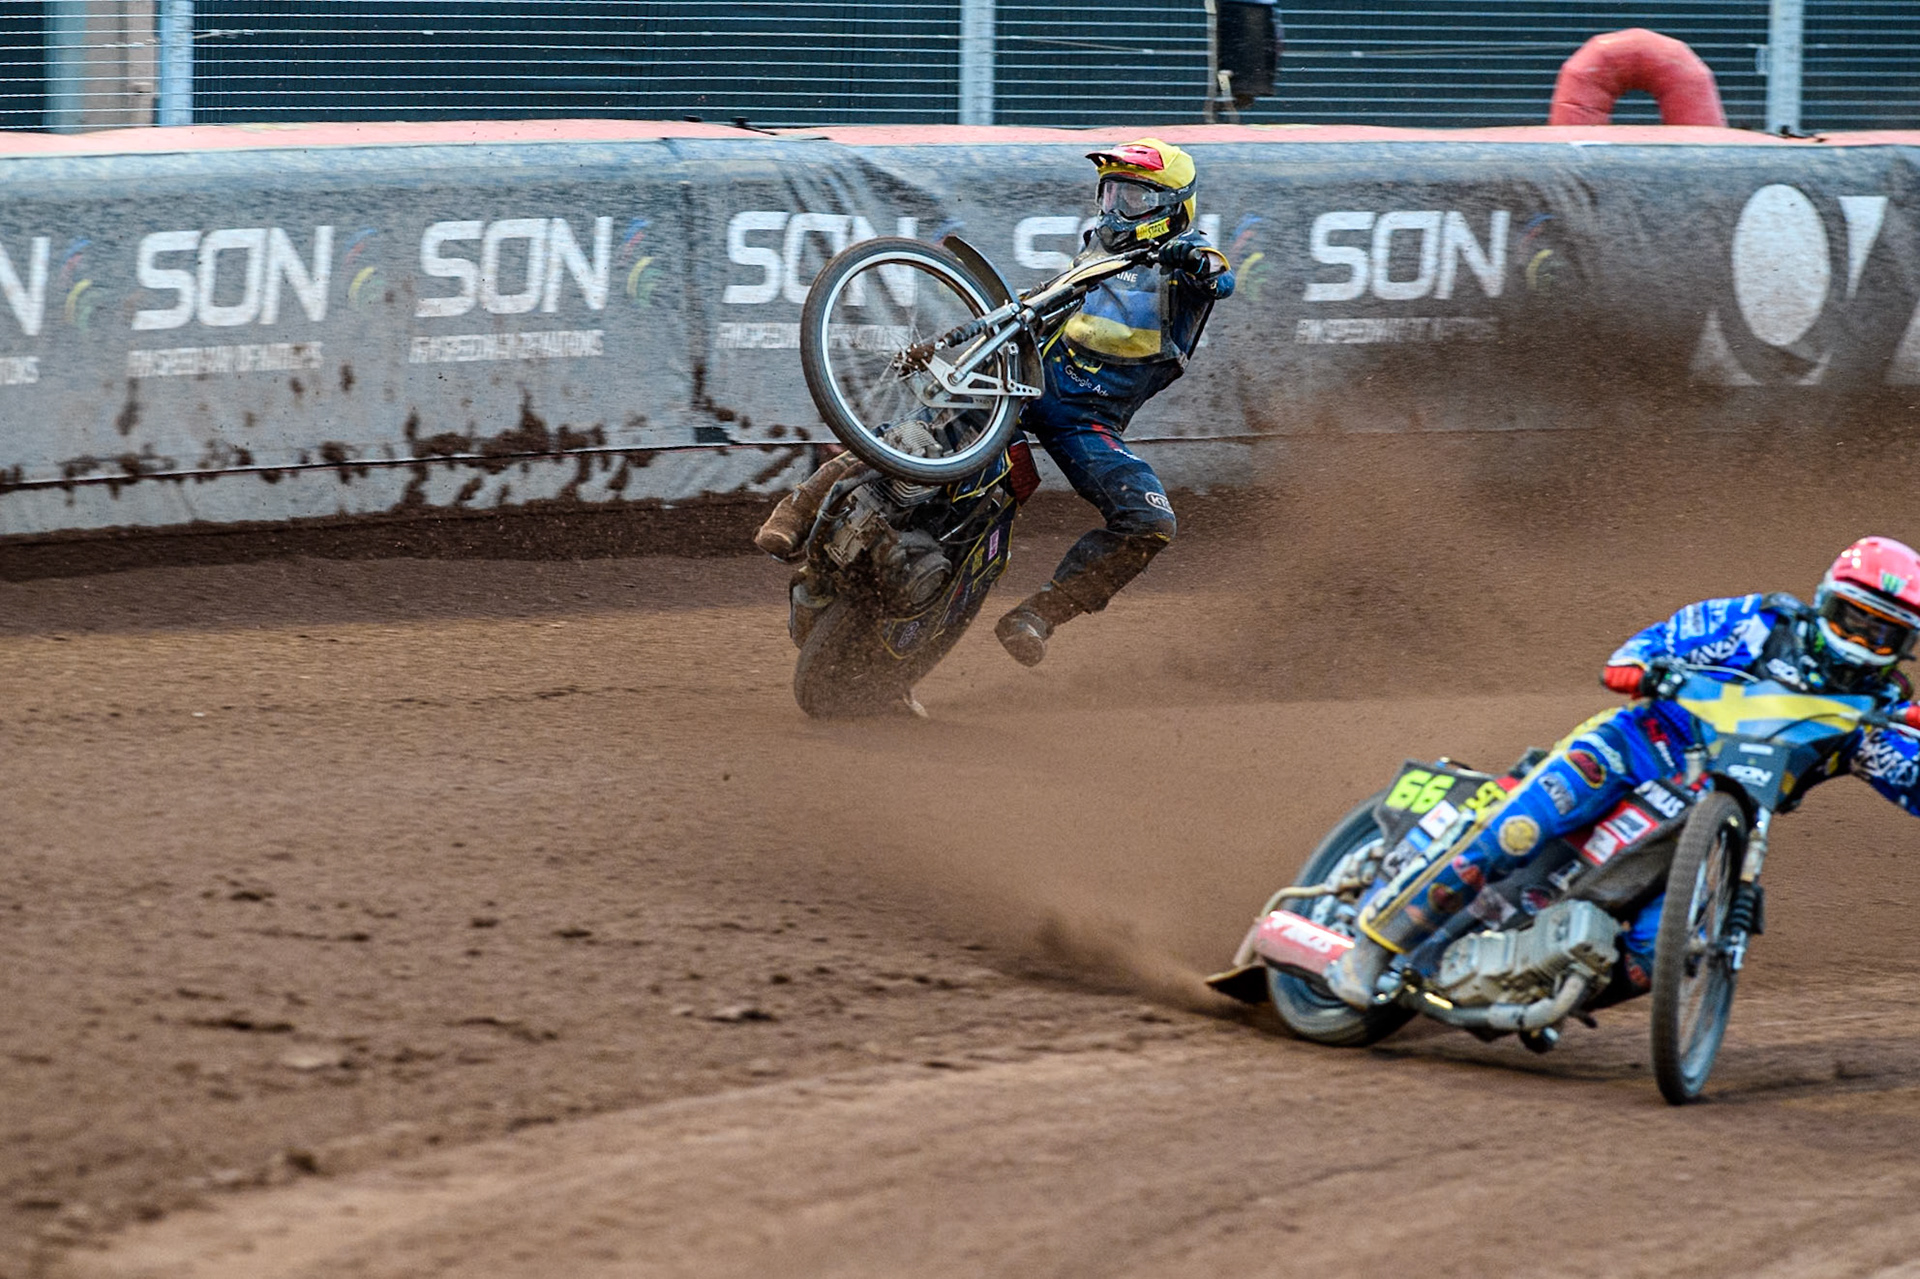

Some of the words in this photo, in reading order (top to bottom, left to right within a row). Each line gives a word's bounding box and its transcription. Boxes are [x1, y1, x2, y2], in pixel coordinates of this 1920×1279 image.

[131, 225, 334, 331] SON
[414, 216, 614, 318] SON
[722, 211, 919, 307] SON
[1303, 210, 1511, 301] SON
[1065, 365, 1093, 388] Google
[1385, 769, 1456, 814] 66
